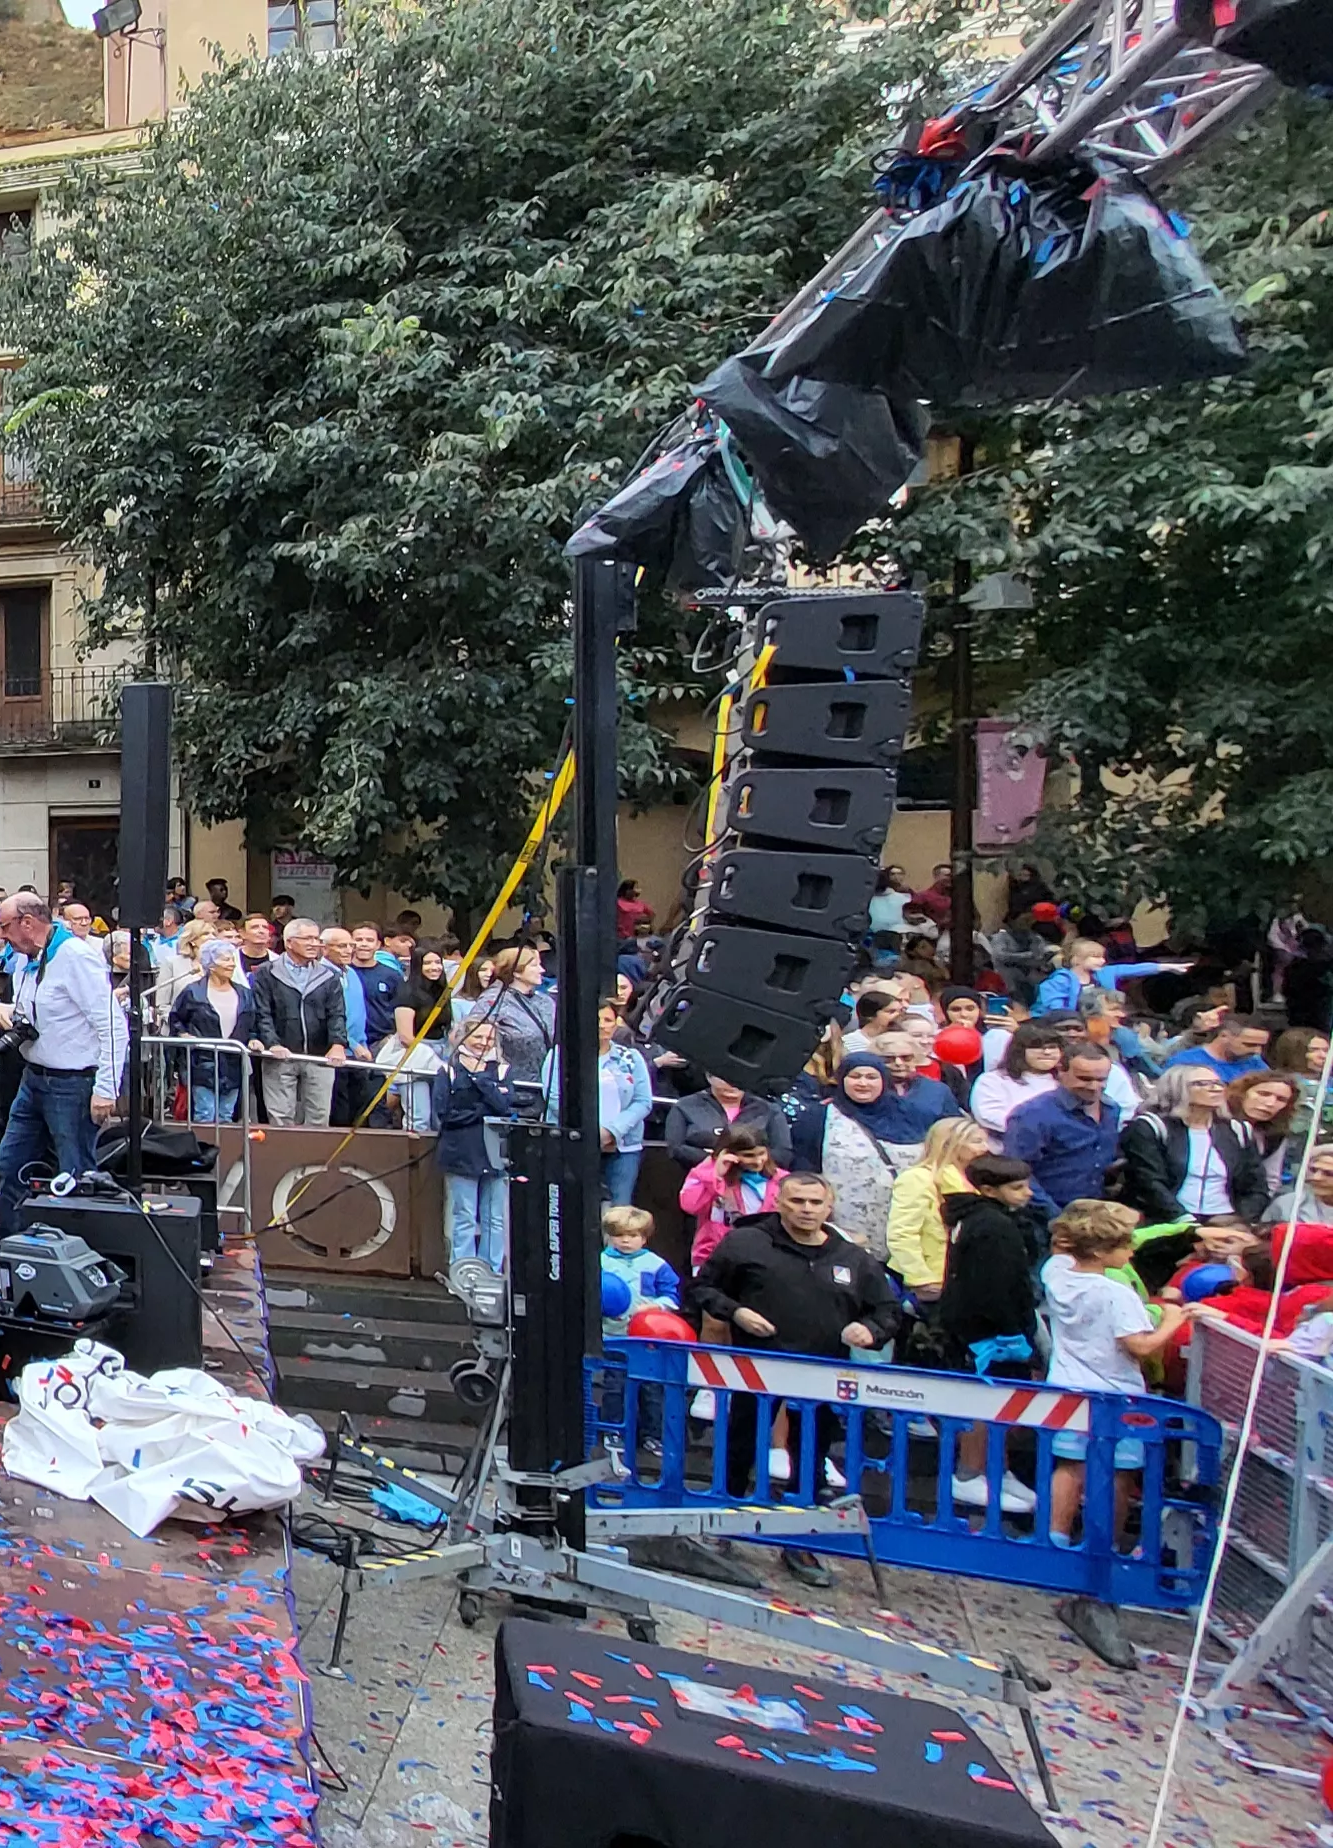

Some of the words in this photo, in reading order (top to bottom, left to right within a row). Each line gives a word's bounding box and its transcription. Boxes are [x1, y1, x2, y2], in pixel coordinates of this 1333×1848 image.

[548, 1183, 560, 1218] TOWER
[548, 1219, 560, 1253] SUPER
[866, 1384, 925, 1400] Monzón
